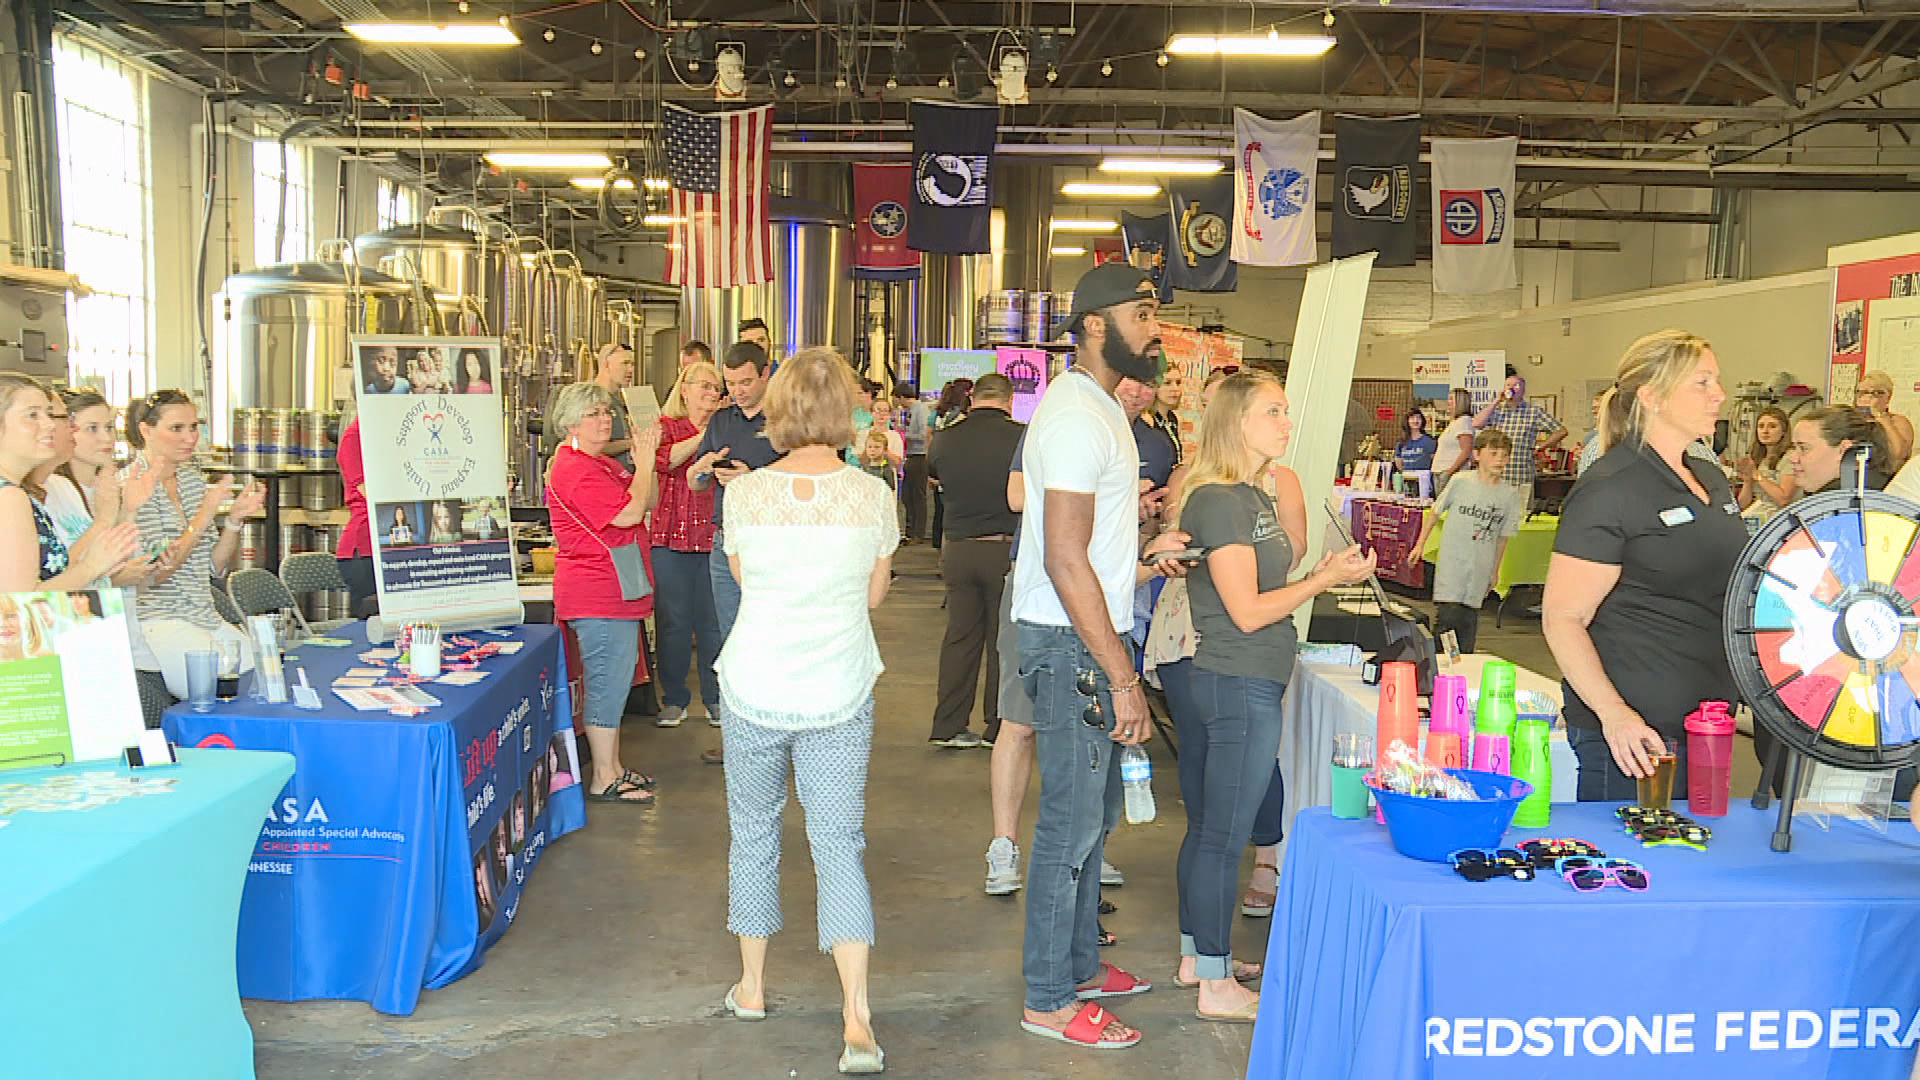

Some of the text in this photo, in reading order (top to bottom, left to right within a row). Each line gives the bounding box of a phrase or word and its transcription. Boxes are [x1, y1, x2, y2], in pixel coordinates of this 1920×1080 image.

[1464, 376, 1488, 388] FEED
[396, 396, 474, 447] Support Develop
[423, 447, 449, 457] CASA
[403, 458, 476, 497] Unite Expand
[261, 826, 316, 839] Appointed
[319, 826, 358, 840] Special
[262, 841, 331, 853] CHILDREN
[1425, 1013, 1695, 1057] REDSTONE
